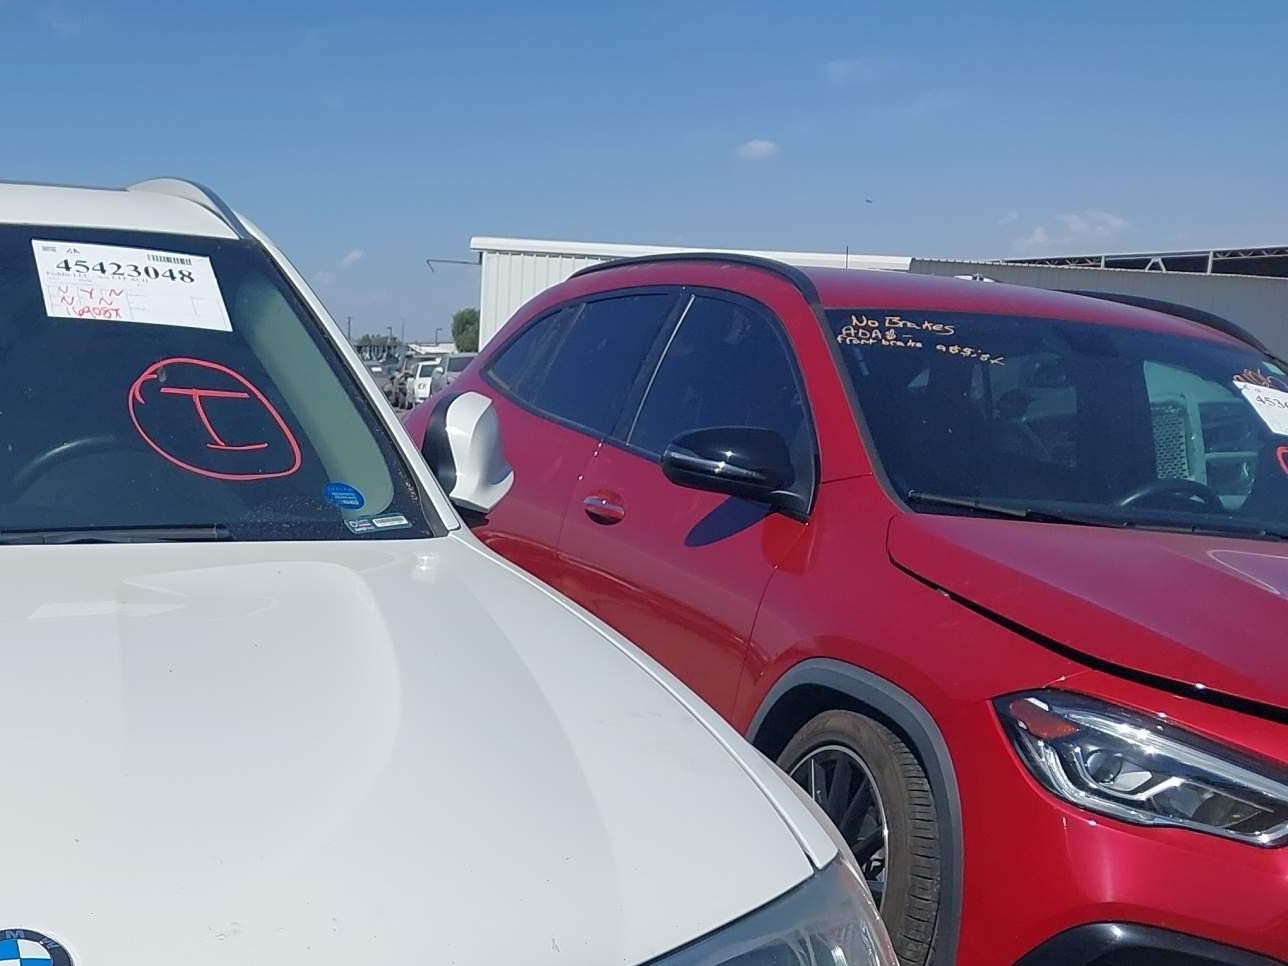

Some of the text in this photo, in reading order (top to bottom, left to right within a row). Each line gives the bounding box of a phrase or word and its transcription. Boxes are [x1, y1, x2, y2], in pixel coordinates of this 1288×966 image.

[55, 258, 196, 284] 45423048
[851, 315, 955, 335] No Brakes
